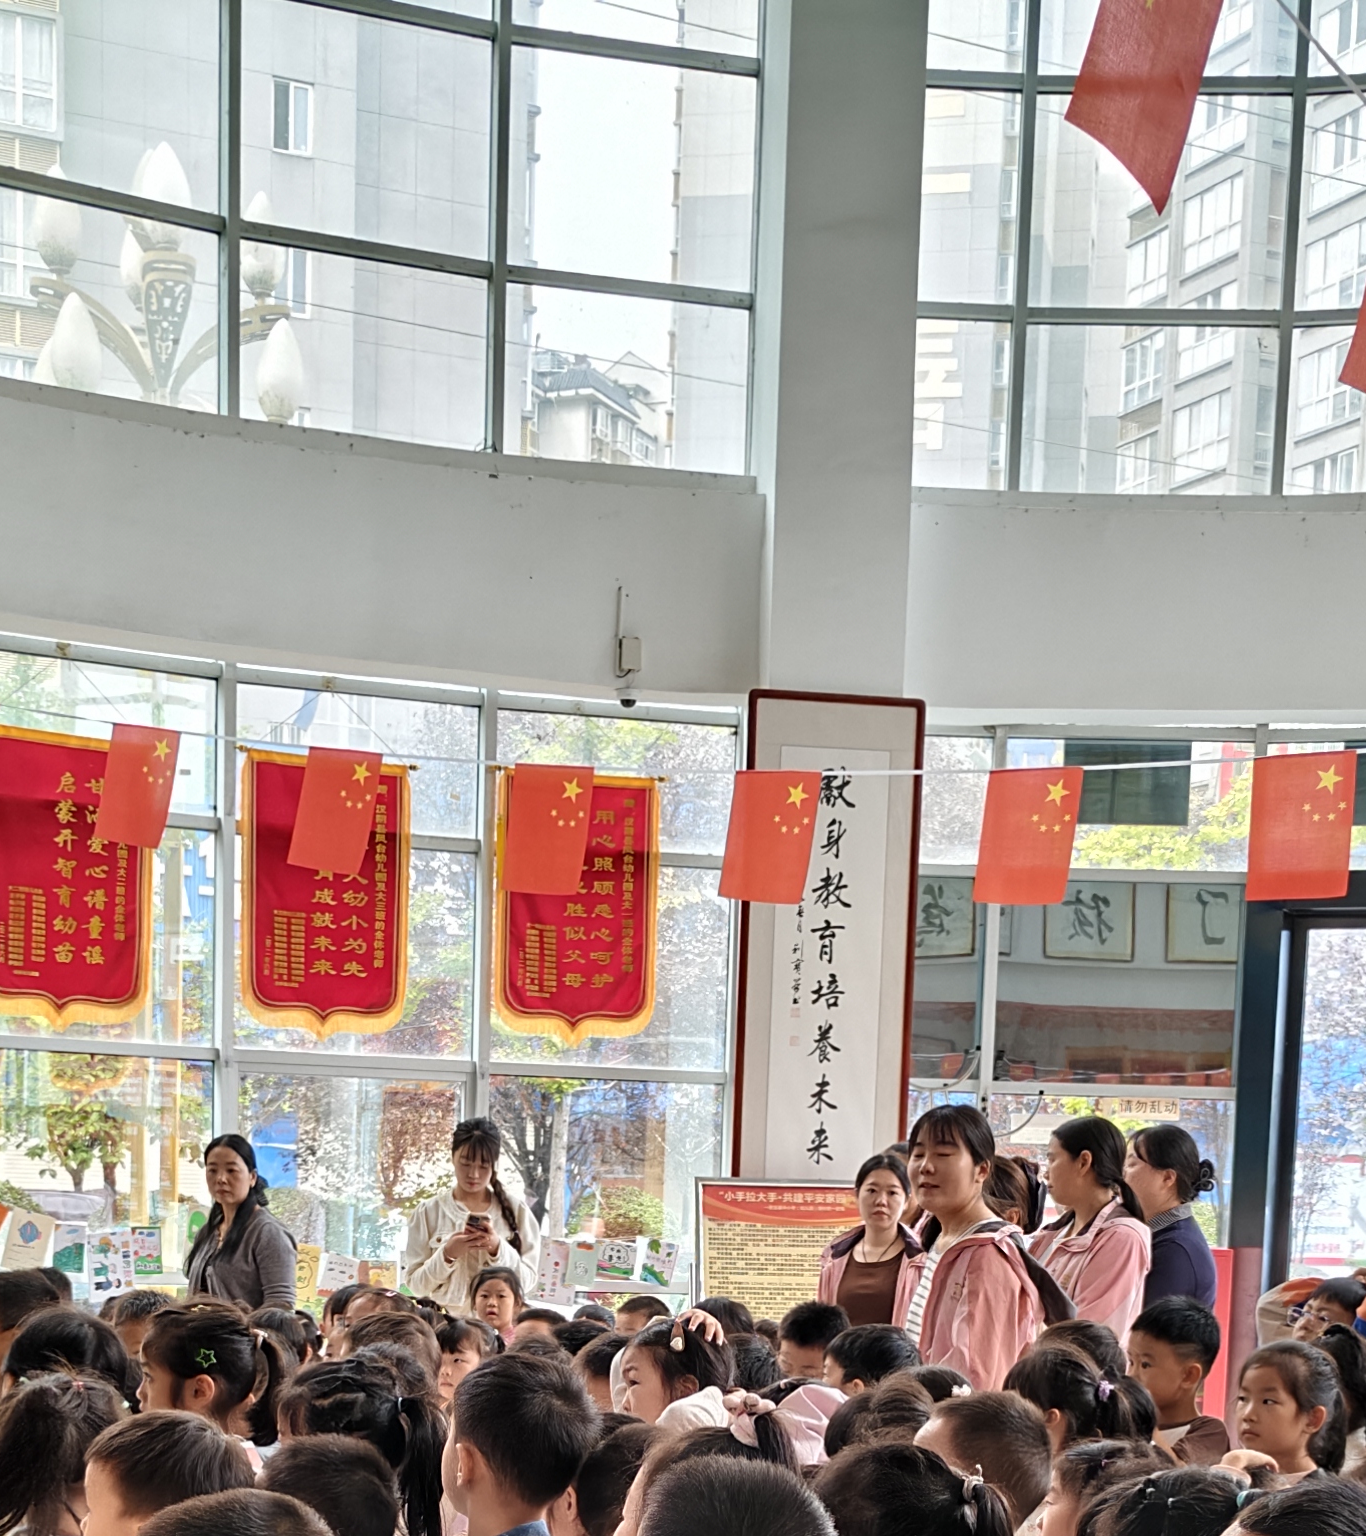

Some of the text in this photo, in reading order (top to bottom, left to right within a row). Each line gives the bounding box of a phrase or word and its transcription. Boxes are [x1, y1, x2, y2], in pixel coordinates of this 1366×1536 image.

[52, 771, 79, 964] 启蒙开智育幼苗
[590, 810, 616, 988] 用心照顾悉心呵护
[1119, 1099, 1178, 1115] 请勿乱动
